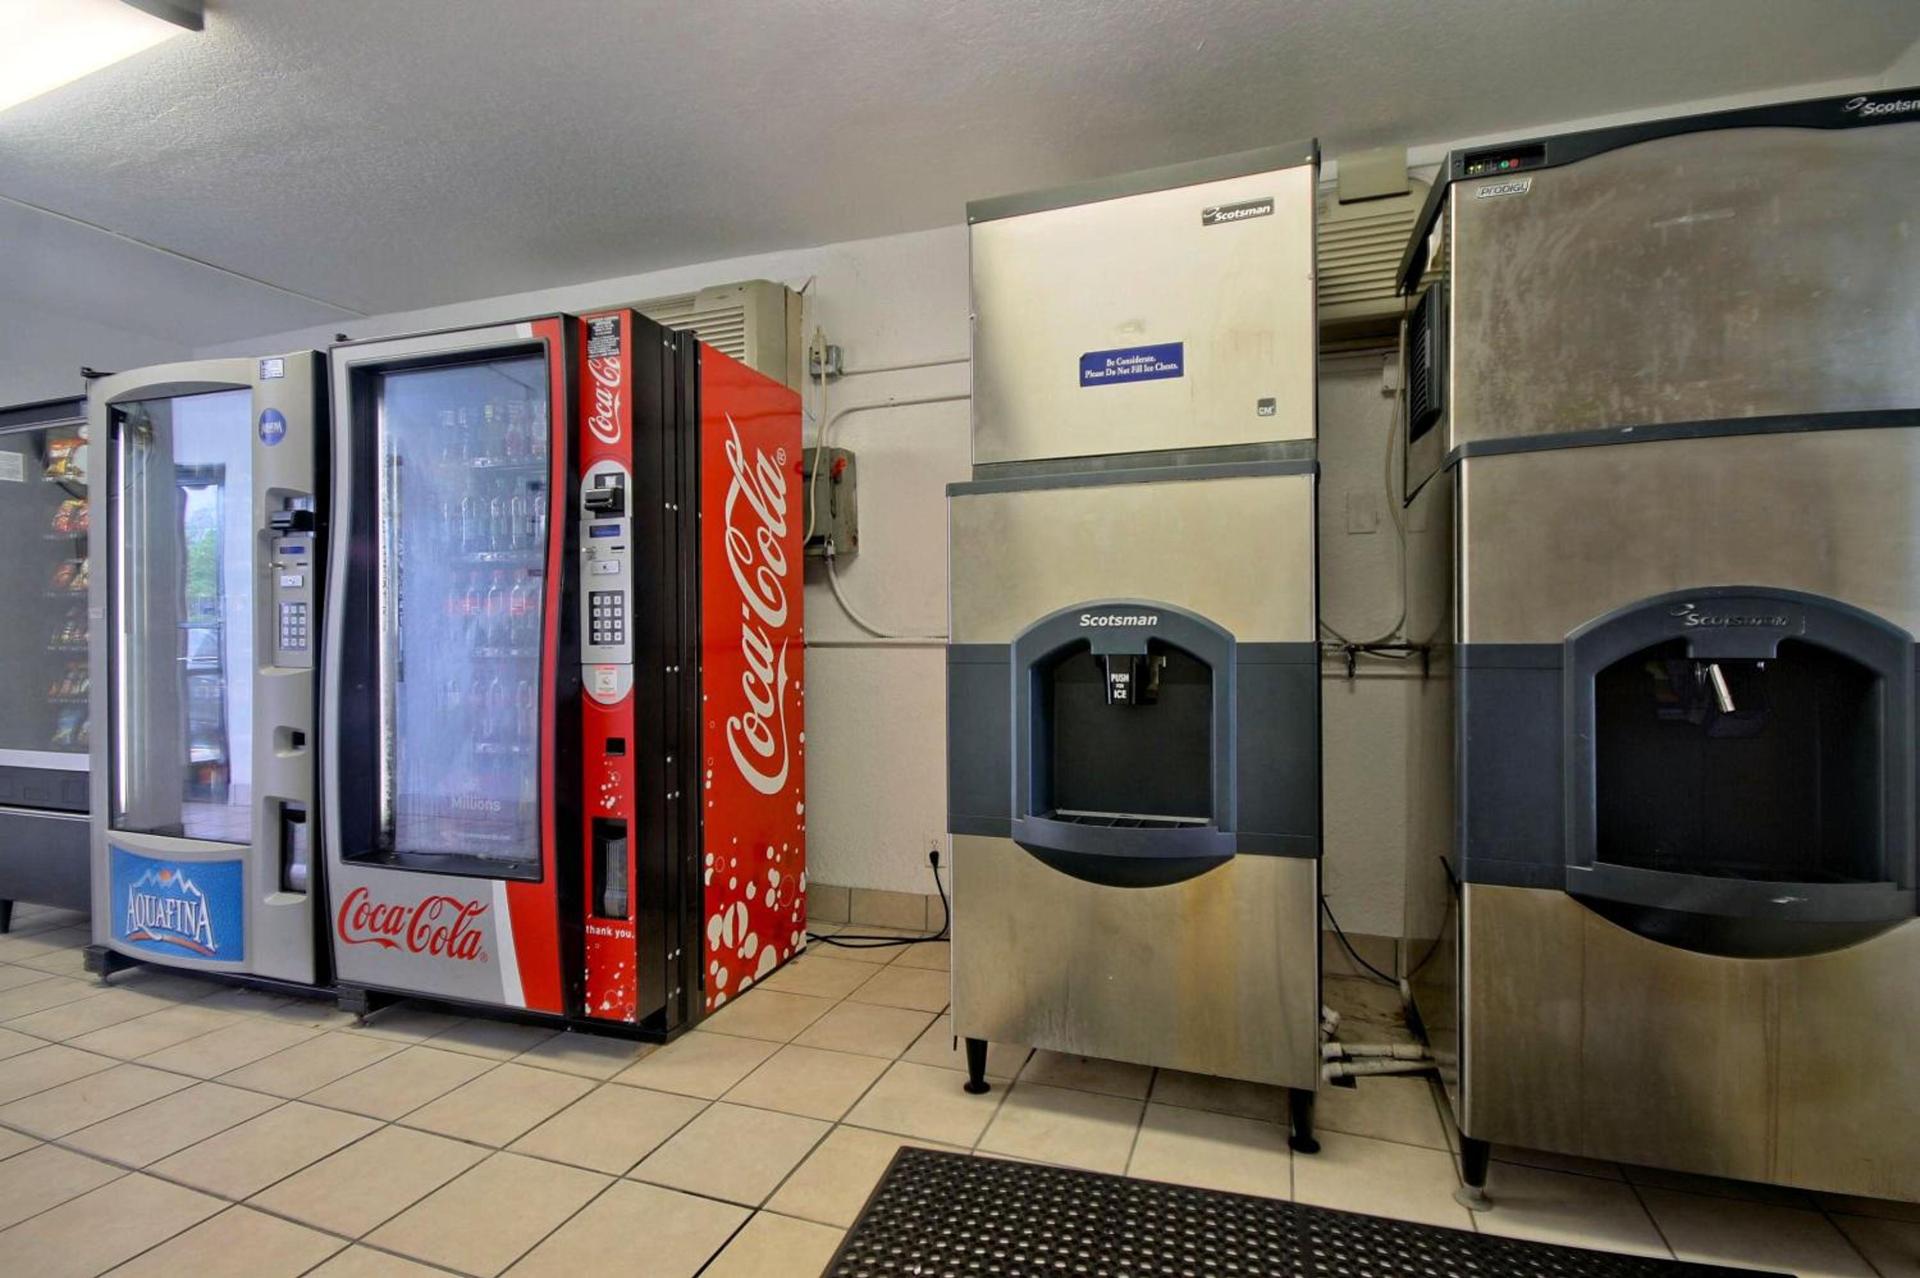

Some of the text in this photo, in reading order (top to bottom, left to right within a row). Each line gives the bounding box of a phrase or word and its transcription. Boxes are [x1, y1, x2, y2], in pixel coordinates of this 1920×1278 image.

[1864, 99, 1920, 114] Scotsm
[1214, 205, 1271, 222] Scotsman
[1085, 370, 1104, 379] Please
[1080, 613, 1158, 627] Scotsman
[1110, 673, 1130, 682] PUSH
[1113, 689, 1127, 699] ICE
[126, 884, 216, 952] AQUAFINA
[586, 925, 613, 936] thank
